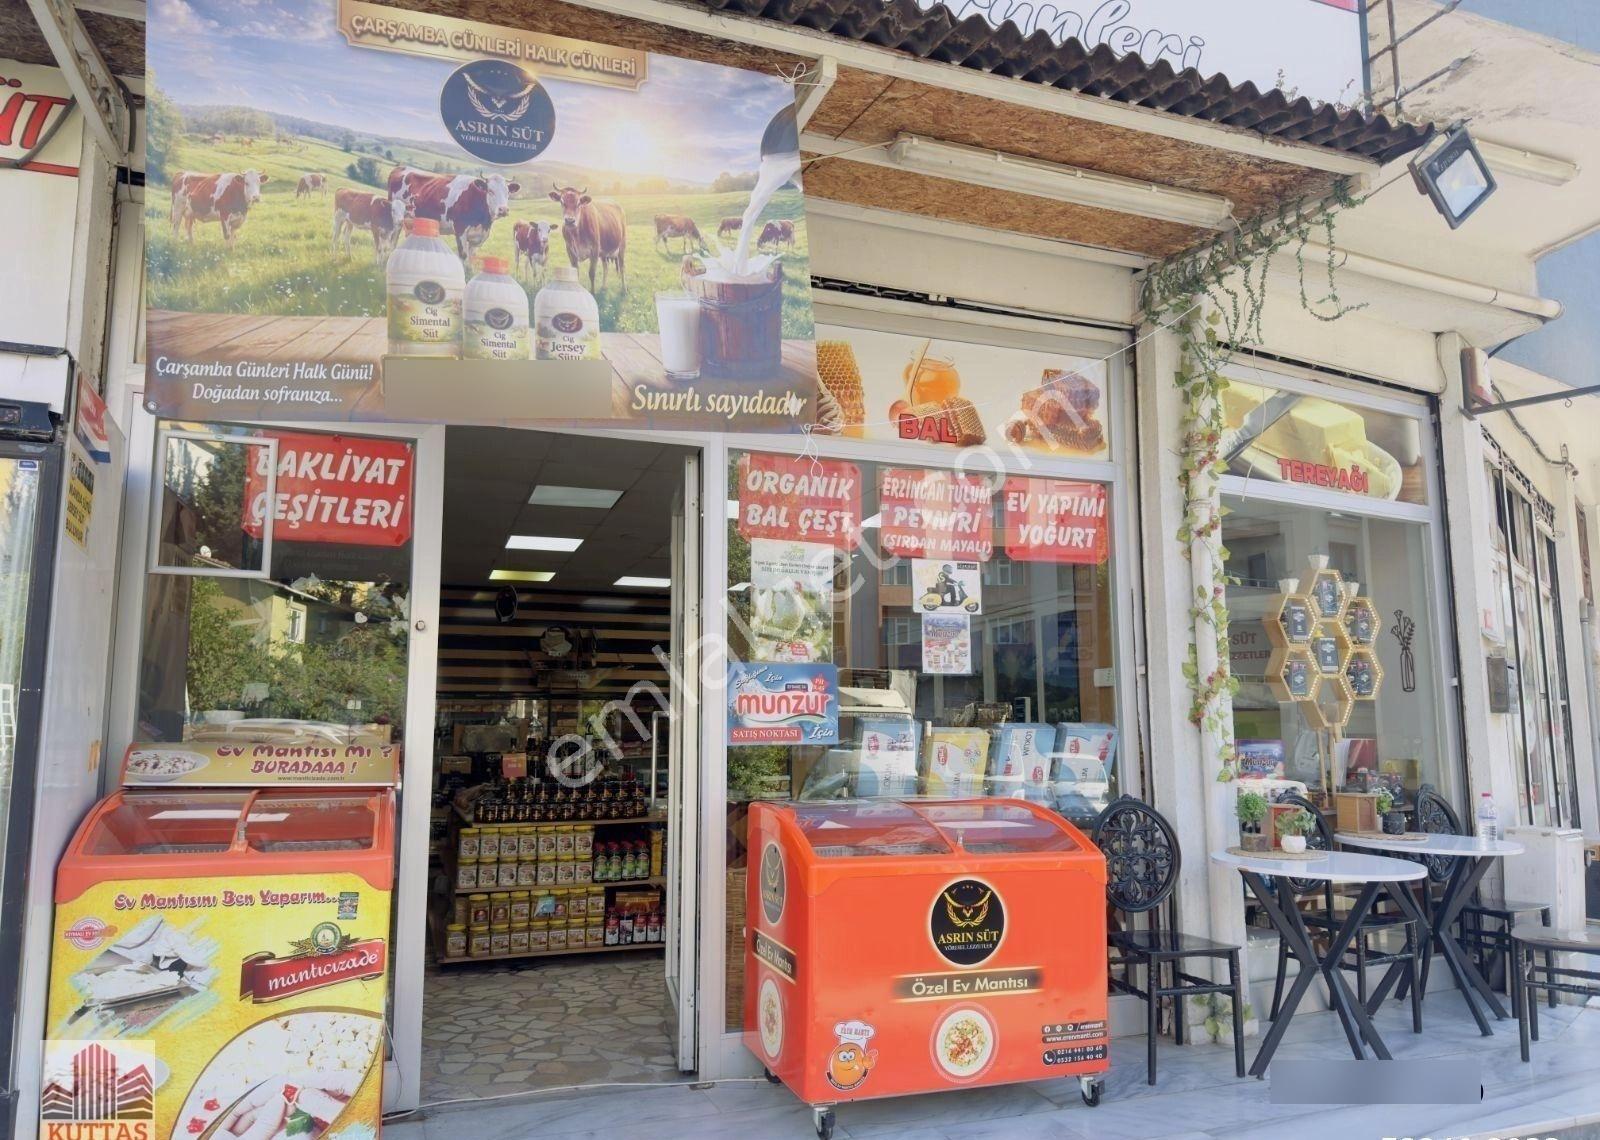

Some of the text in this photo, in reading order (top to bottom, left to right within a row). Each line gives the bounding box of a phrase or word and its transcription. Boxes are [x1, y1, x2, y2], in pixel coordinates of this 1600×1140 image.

[351, 15, 636, 76] ÇARŞAMBA GÜNLERİ HALK GÜNLERİ
[456, 119, 544, 142] ASRIN SÜT
[410, 316, 451, 328] Simental
[422, 327, 439, 339] Süt
[481, 339, 517, 349] Simental
[551, 342, 586, 354] Jersey
[155, 356, 373, 381] Çarşamba Günleri Halk Günü!
[192, 383, 343, 405] Doğadan sofranıza...
[631, 384, 807, 420] Sınırlı sayıdadr
[899, 413, 958, 444] BAL
[255, 447, 405, 486] BAKLİYAT
[1276, 457, 1369, 493] TEREYAĞI
[746, 469, 855, 502] ORGANİK
[250, 488, 405, 530] ÇEŞİTLERİ
[1007, 491, 1105, 518] EV YAPIMI
[746, 504, 790, 529] BAL
[1018, 521, 1097, 549] YOĞURT
[737, 694, 830, 715] munzur
[733, 729, 798, 739] SATIŞ NOKTASI
[808, 724, 834, 740] İçin
[216, 744, 249, 757] Ev
[250, 760, 346, 775] BURADAAA
[114, 892, 136, 910] Ev
[141, 891, 218, 910] Mantısını
[222, 890, 255, 906] Ben
[937, 928, 1000, 944] ASRIN SÜT
[911, 976, 1029, 996] Özel Ev Mantısı
